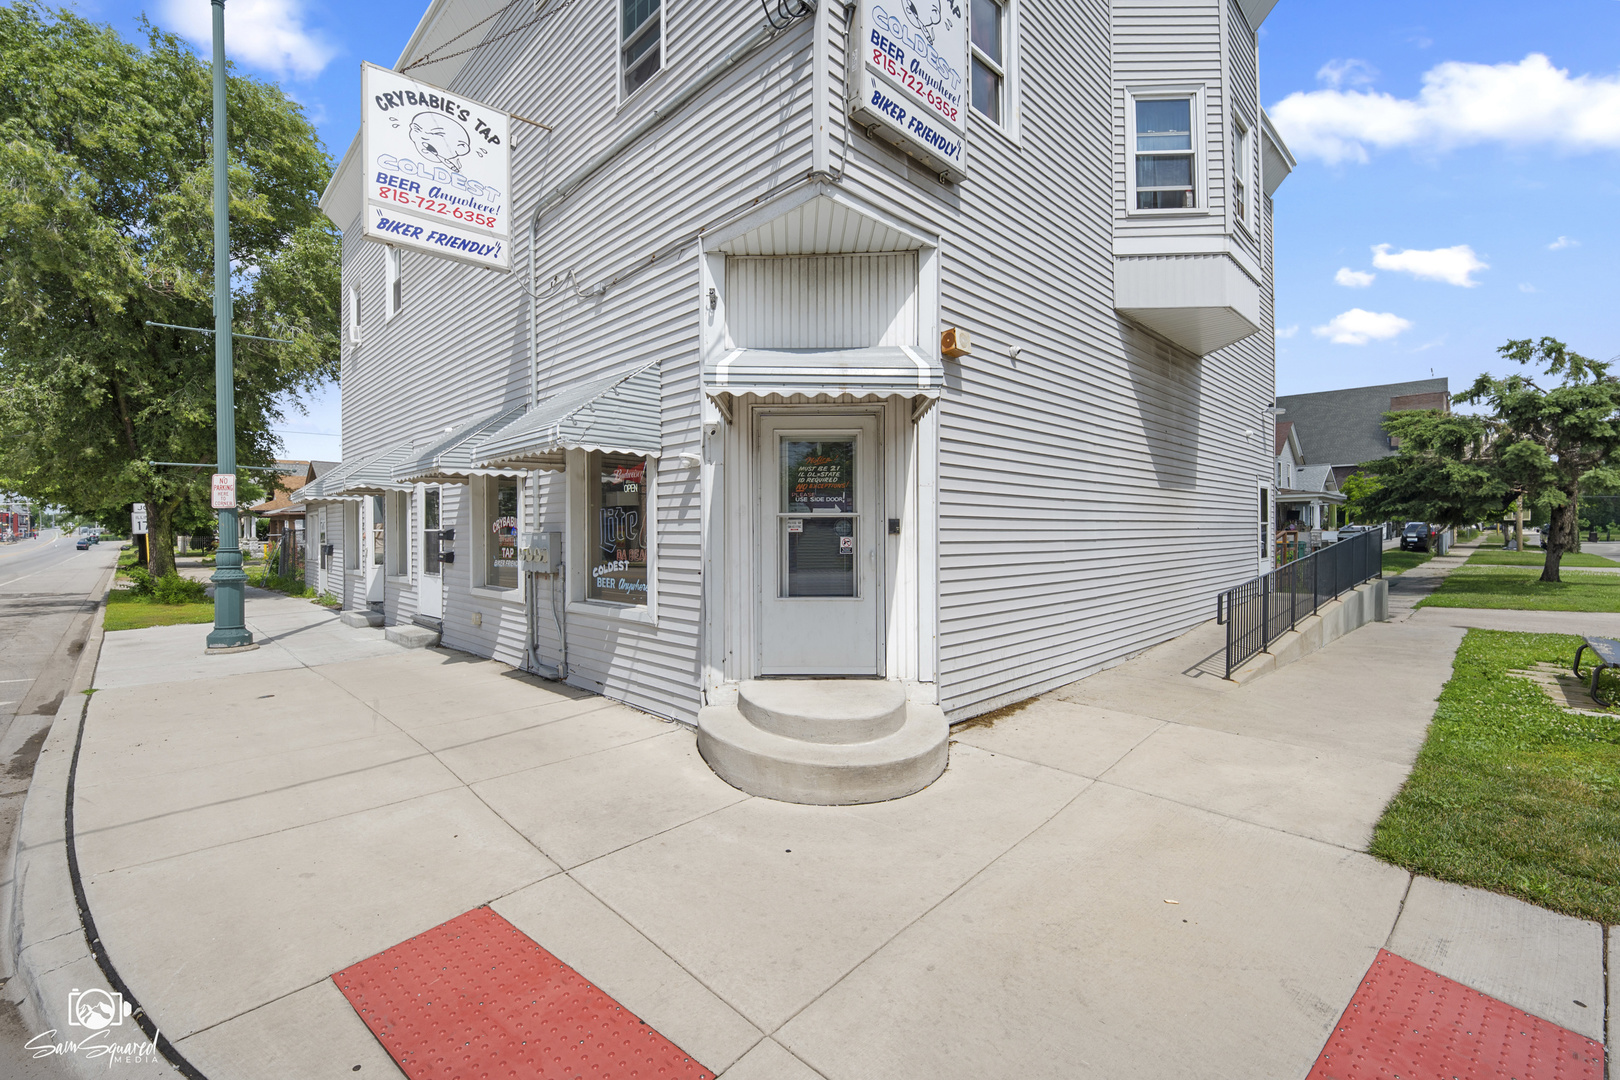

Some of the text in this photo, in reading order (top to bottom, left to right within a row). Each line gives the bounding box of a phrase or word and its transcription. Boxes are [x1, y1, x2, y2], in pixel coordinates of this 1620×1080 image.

[870, 29, 905, 65] BEER
[872, 5, 961, 90] COLDEST
[873, 49, 958, 122] 815-722-6358
[375, 90, 500, 146] CRYBABIE'S TAP
[376, 172, 420, 194] BEER
[377, 154, 501, 202] COLDEST
[379, 186, 497, 228] 815-722-6358
[624, 484, 638, 492] OPEN
[795, 481, 850, 491] NO EXCEPTIONS!
[826, 492, 845, 503] DOOR!
[138, 521, 148, 530] 17
[492, 516, 518, 534] CRYBABI
[599, 507, 638, 553] Lite
[502, 548, 514, 558] TAP
[629, 549, 647, 561] BEA
[592, 560, 630, 578] COLDEST
[597, 577, 616, 589] BEER
